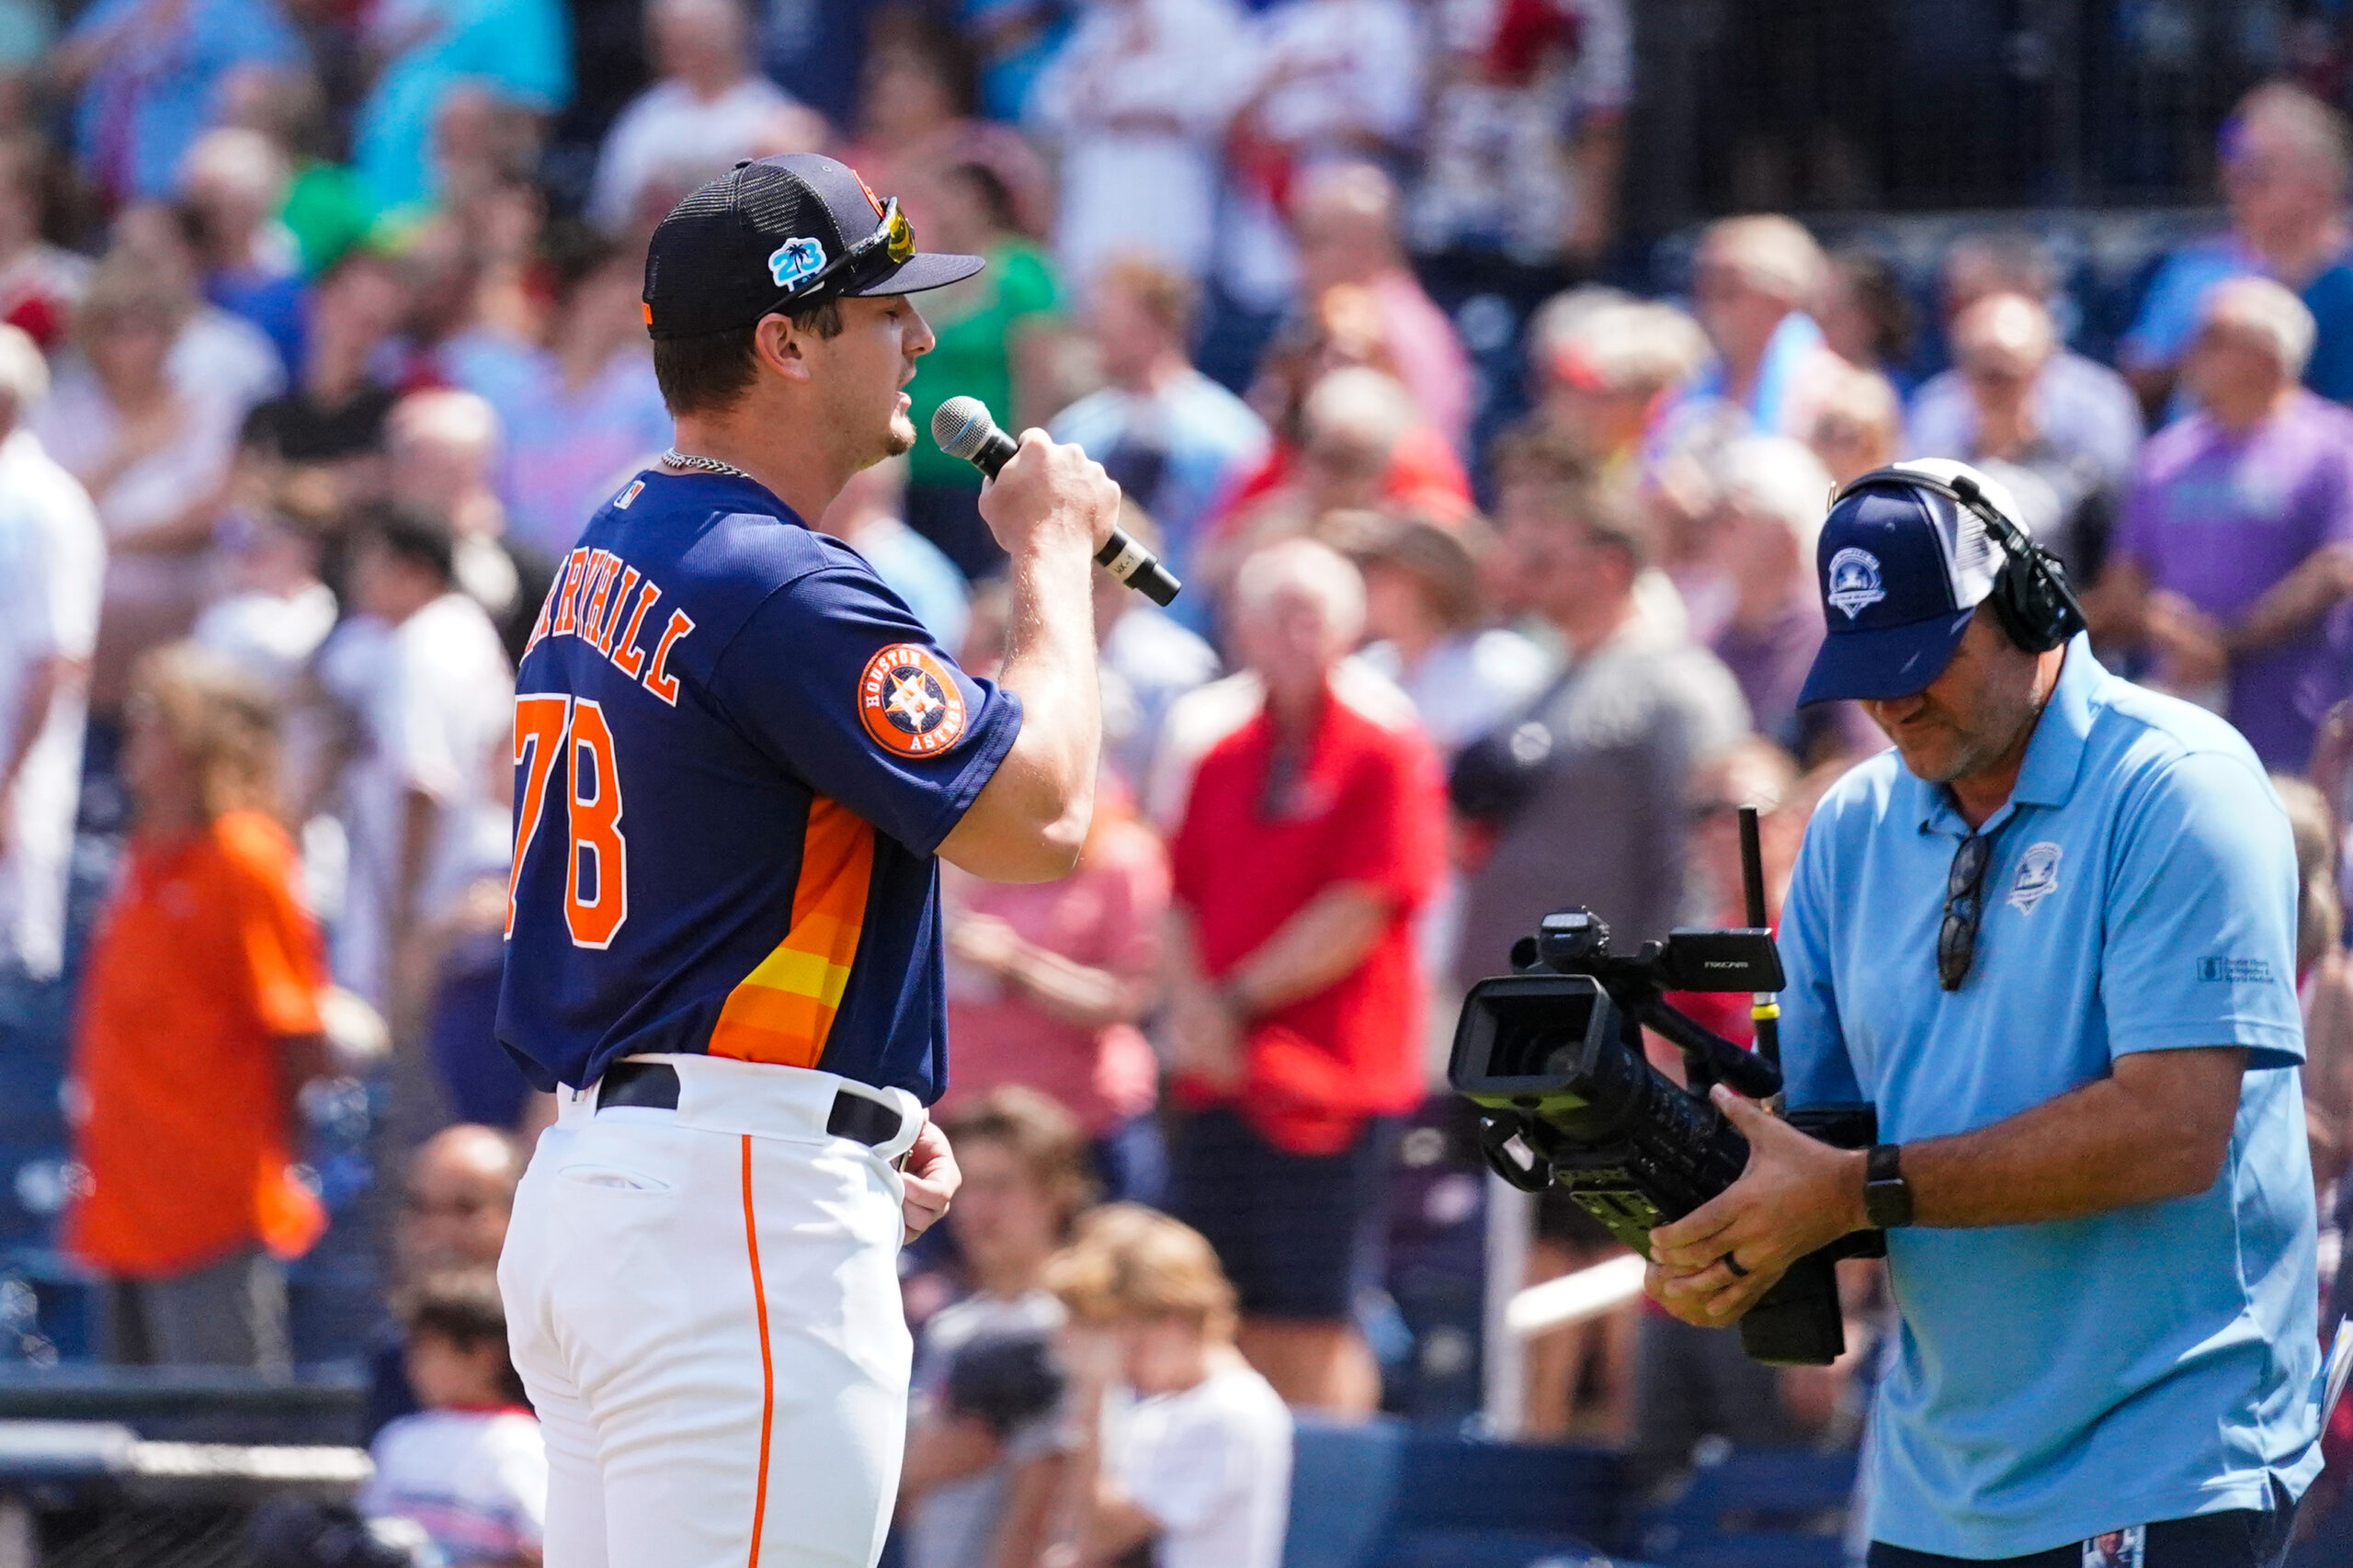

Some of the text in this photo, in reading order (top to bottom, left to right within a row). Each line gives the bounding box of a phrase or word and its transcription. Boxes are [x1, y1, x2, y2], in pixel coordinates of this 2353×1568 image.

[773, 242, 822, 281] 23
[866, 649, 921, 708] HOUSTON
[910, 699, 961, 750] ASTROS
[504, 693, 628, 950] 78
